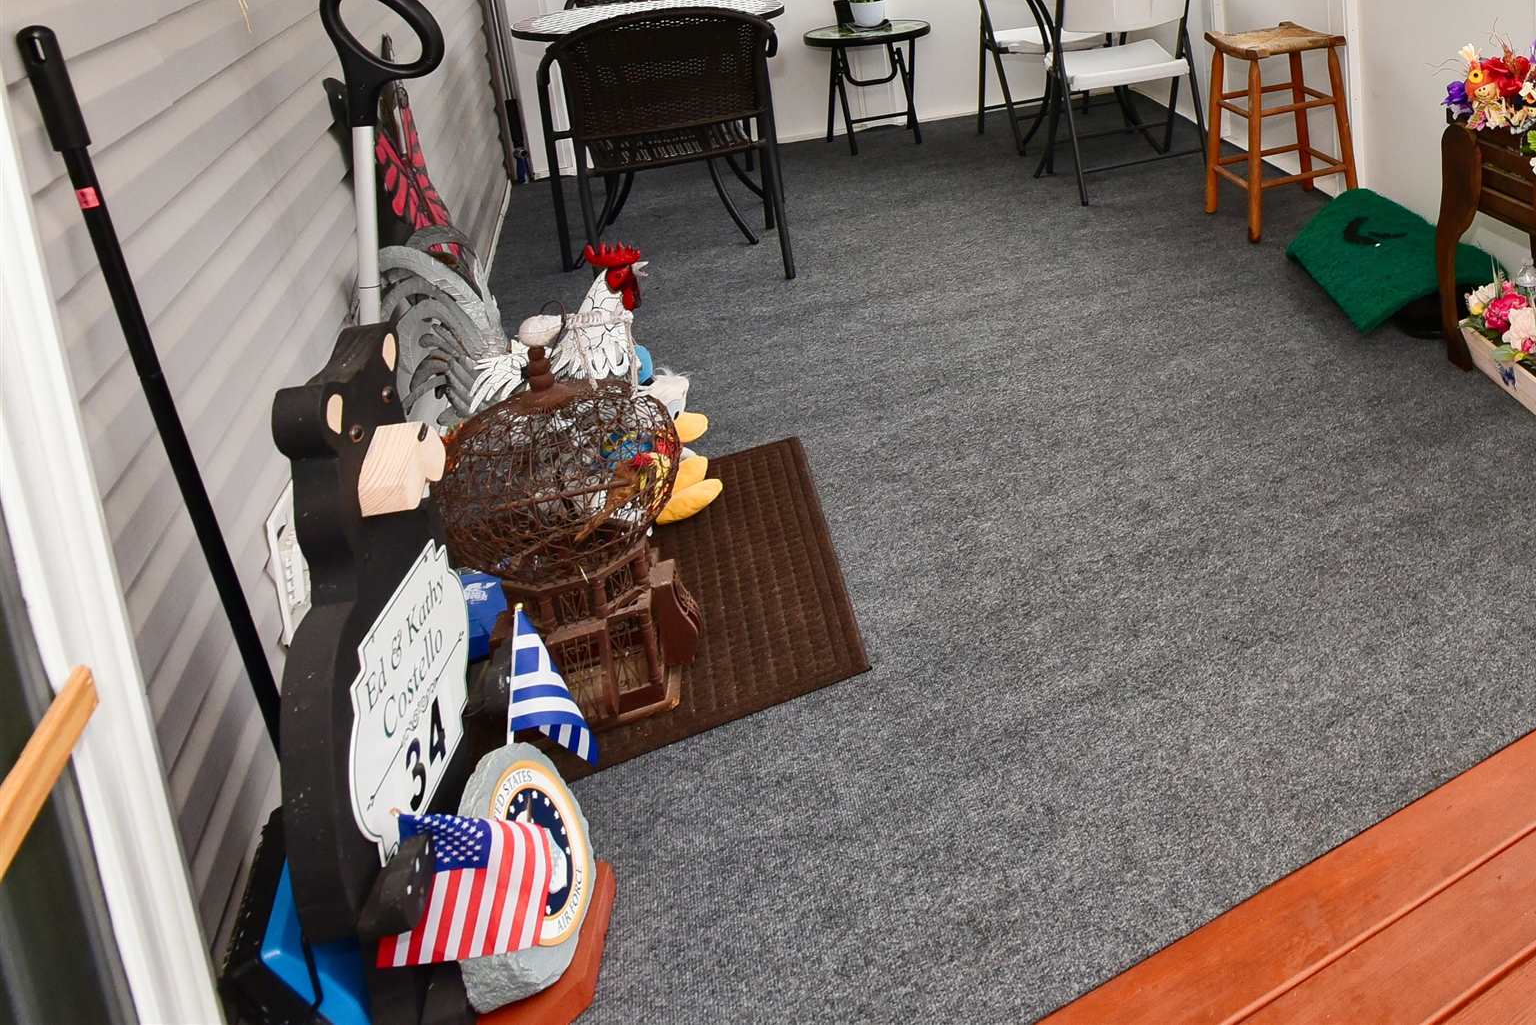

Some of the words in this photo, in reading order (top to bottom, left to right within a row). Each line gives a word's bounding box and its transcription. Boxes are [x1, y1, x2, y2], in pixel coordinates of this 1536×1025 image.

[365, 656, 387, 710] Ed
[391, 628, 402, 670] &
[406, 575, 444, 646] Kathy
[383, 629, 443, 738] Costello
[406, 695, 446, 812] 34
[503, 770, 533, 791] STATES
[558, 911, 572, 931] AIR
[568, 865, 583, 915] FORCE
